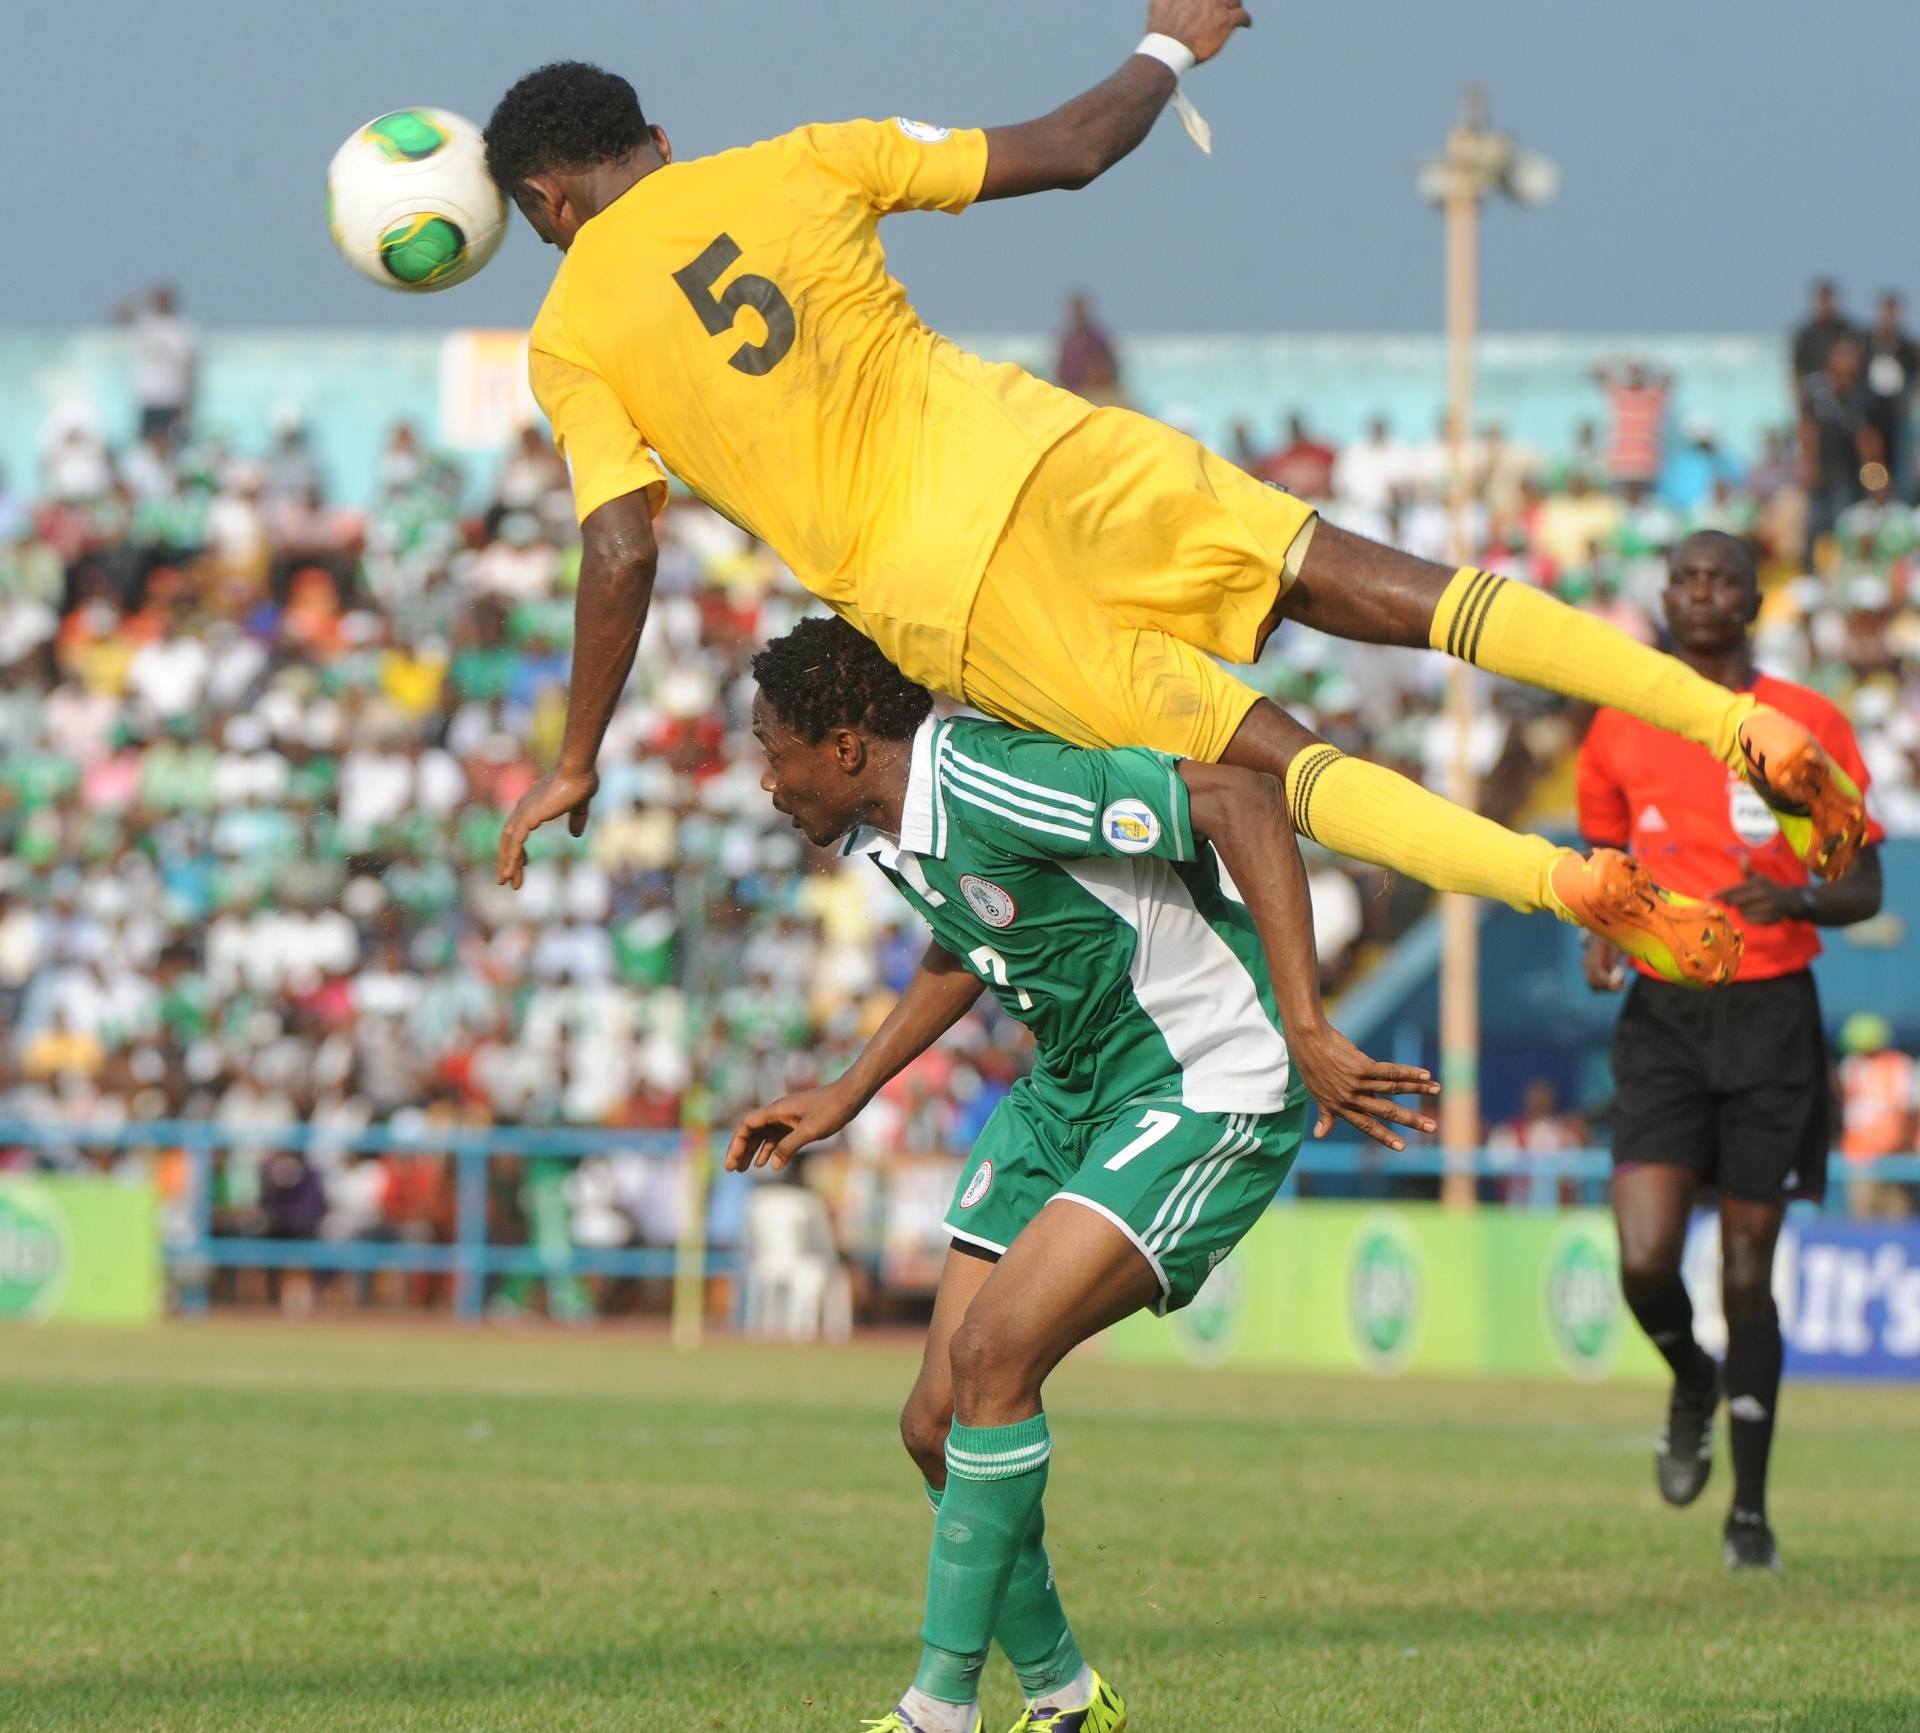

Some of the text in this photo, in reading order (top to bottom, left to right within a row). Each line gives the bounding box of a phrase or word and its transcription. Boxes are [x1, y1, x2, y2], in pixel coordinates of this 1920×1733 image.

[670, 231, 796, 376] 5
[968, 945, 1034, 1011] 7
[1102, 1108, 1182, 1172] 7
